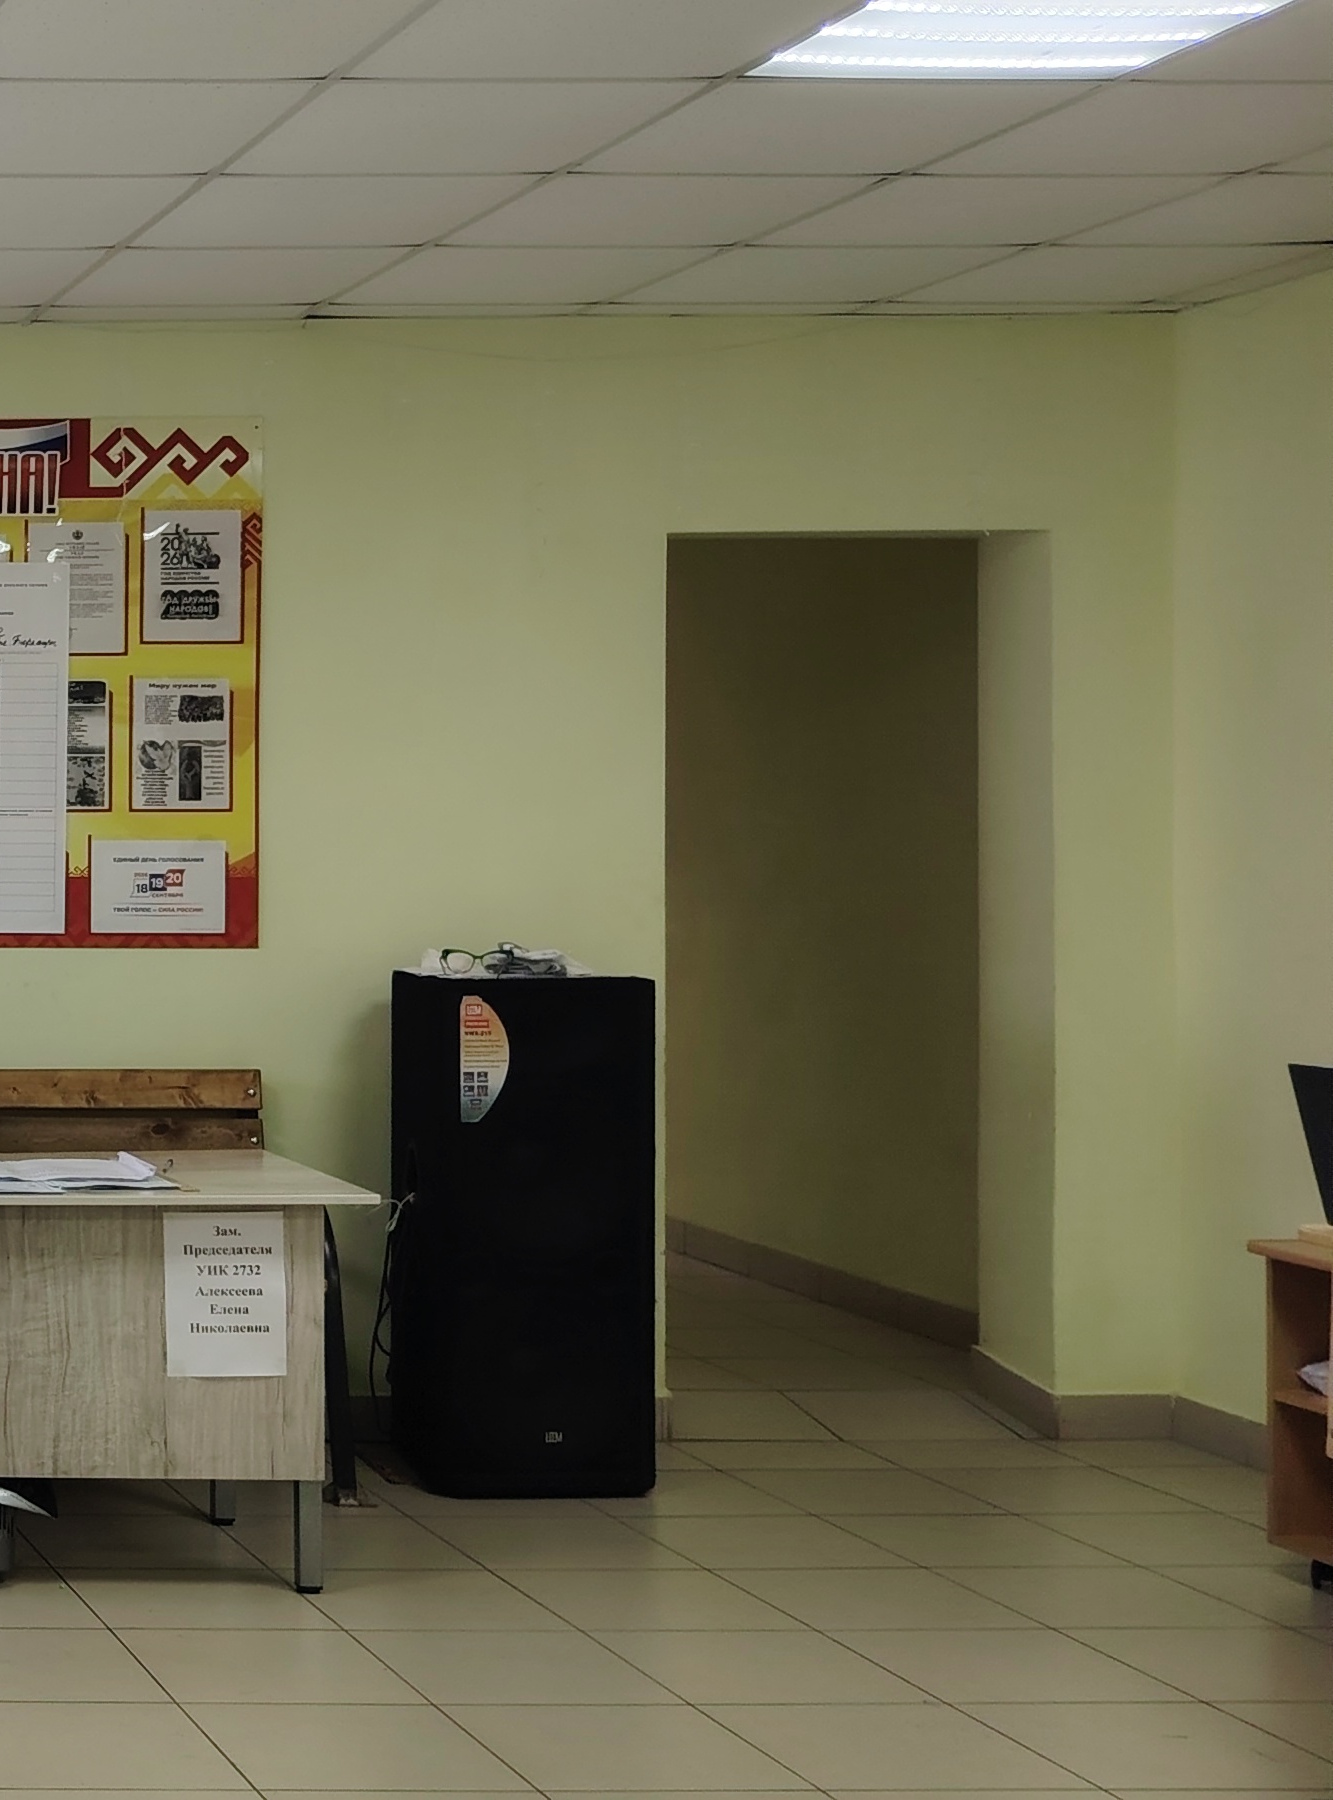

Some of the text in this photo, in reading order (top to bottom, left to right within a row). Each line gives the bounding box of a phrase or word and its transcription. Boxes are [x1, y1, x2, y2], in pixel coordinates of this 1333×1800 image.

[135, 872, 182, 894] 18 19 20
[212, 1225, 242, 1237] Зам.
[182, 1244, 273, 1258] Председателя
[196, 1264, 262, 1276] УИК 2732
[194, 1285, 264, 1297] Алексеева
[209, 1303, 250, 1315] Елена
[189, 1322, 271, 1334] Николаевна
